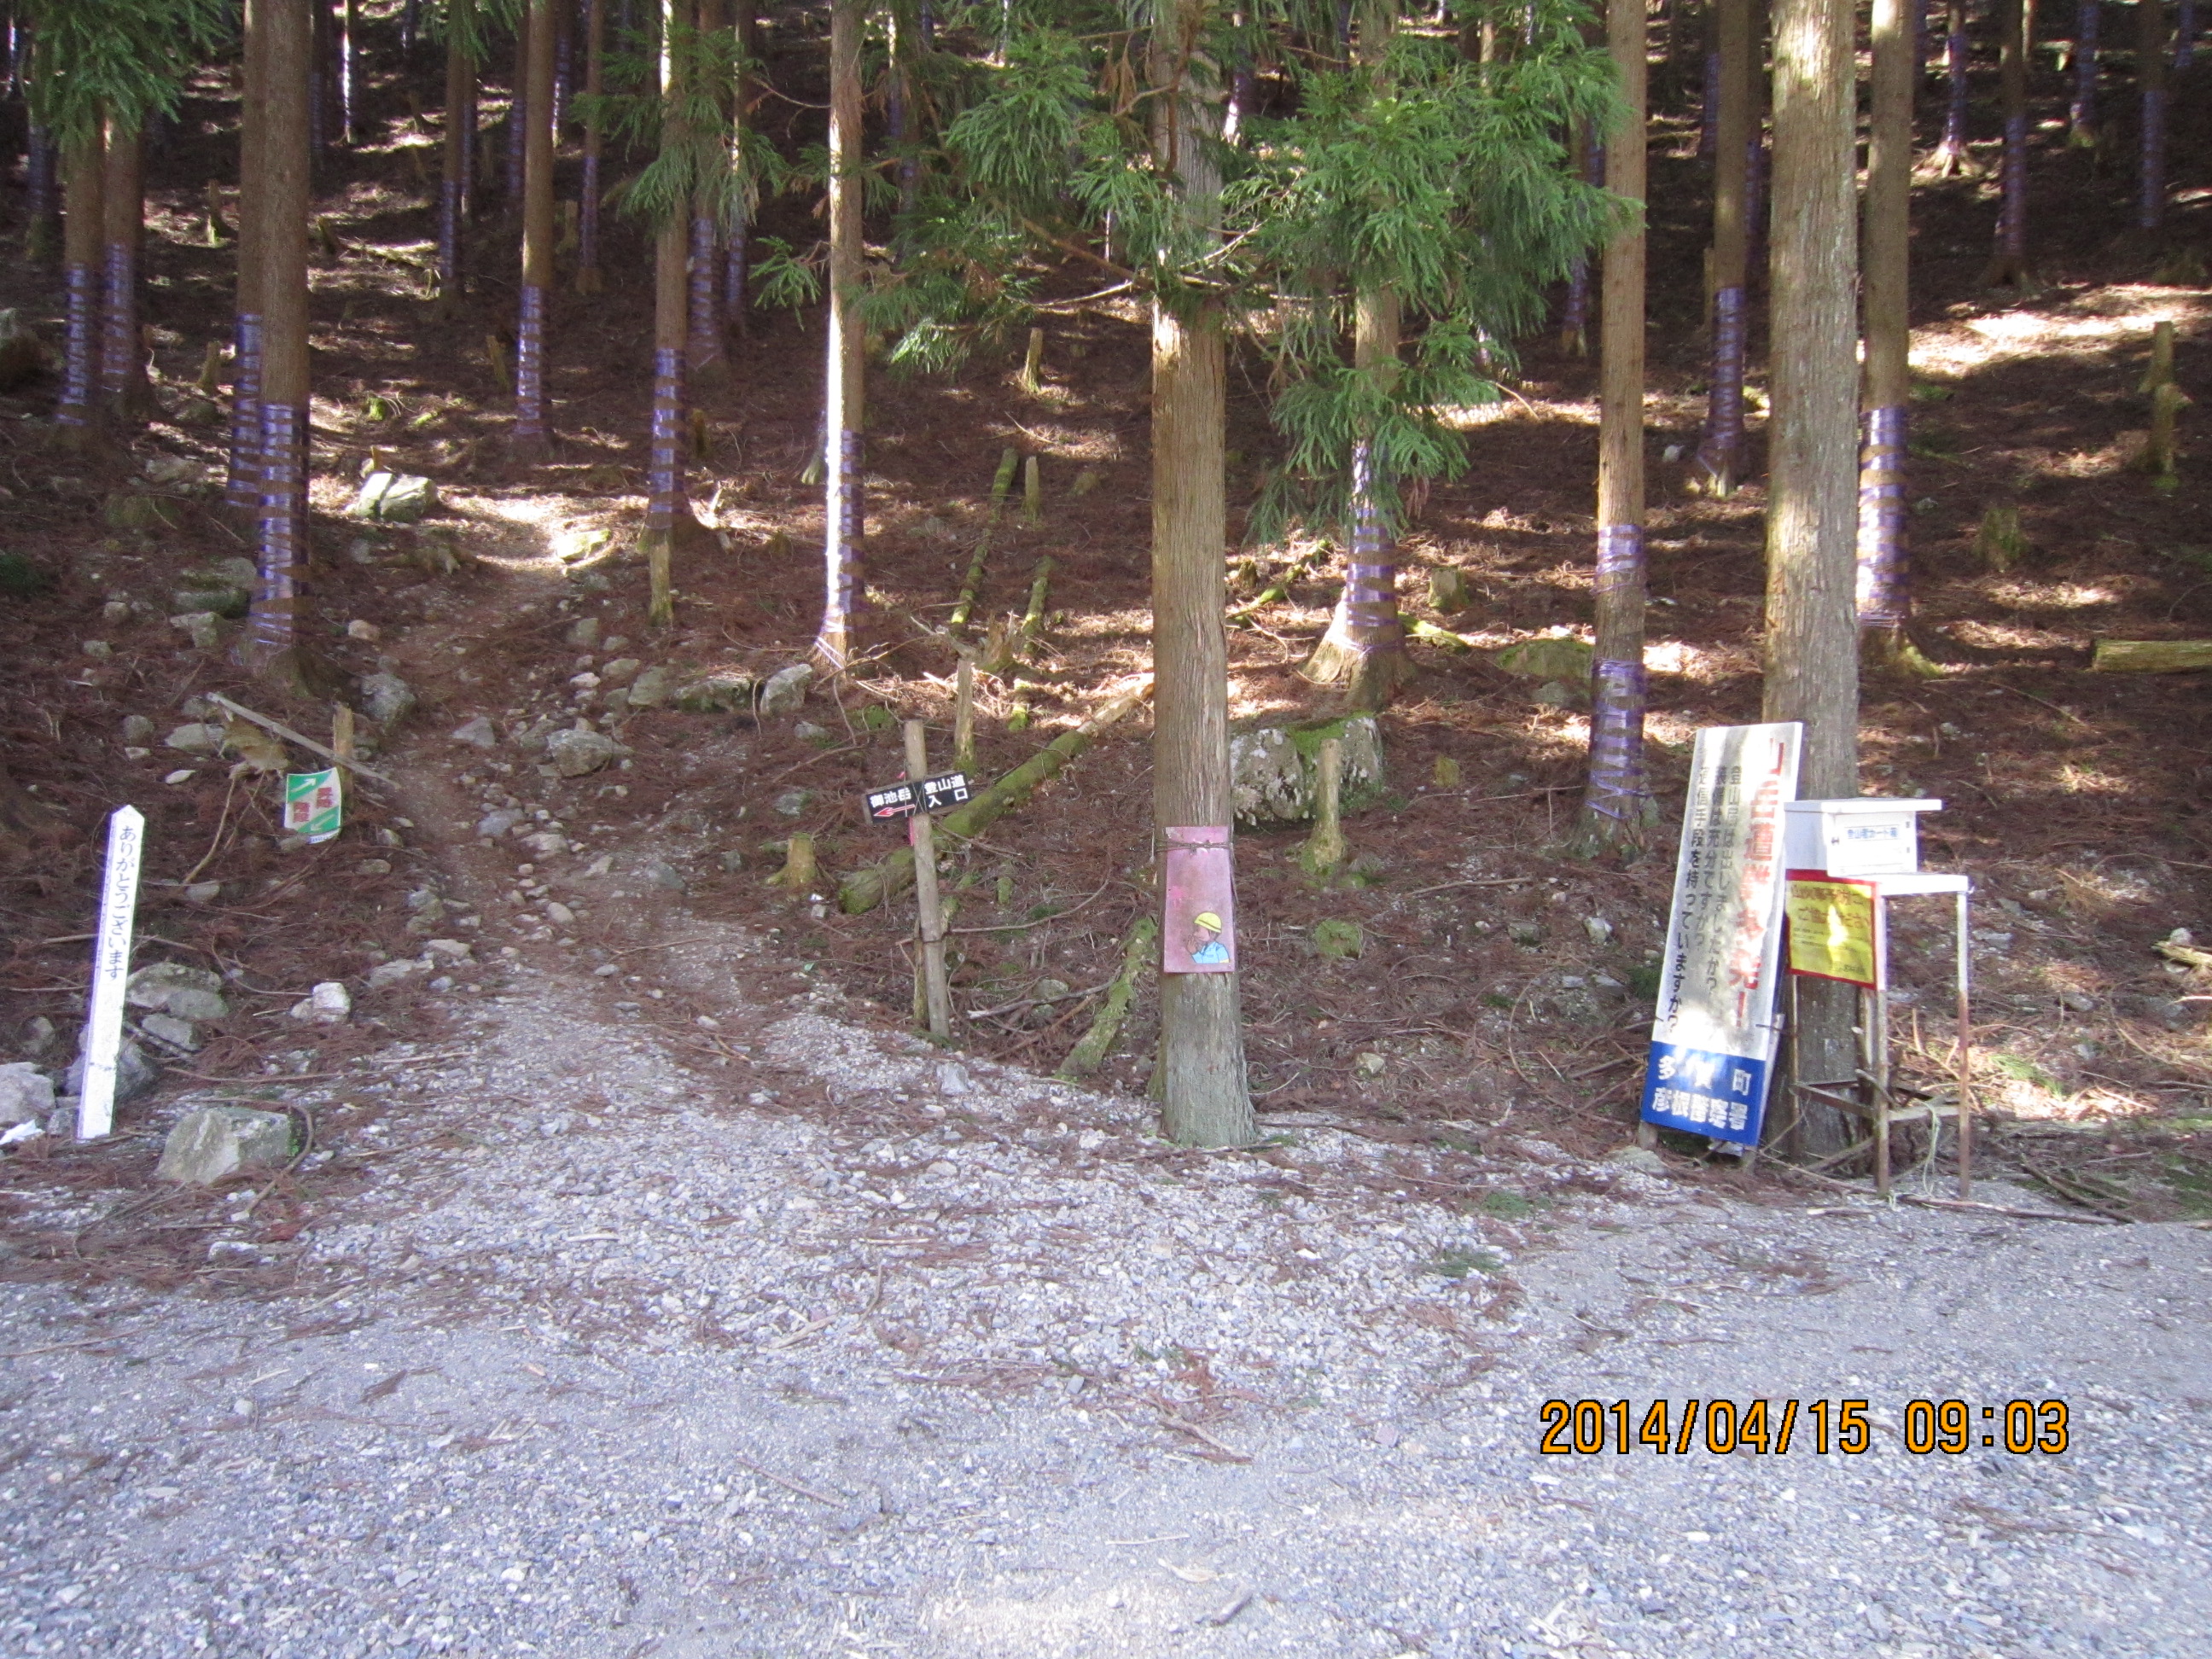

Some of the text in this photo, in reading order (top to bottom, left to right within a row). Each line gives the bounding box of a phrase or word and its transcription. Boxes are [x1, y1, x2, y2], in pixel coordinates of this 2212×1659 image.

[870, 787, 911, 807] 御池岳
[924, 774, 965, 795] 登山道
[105, 825, 137, 981] ありがとうございます
[1652, 1087, 1749, 1131] 彦根警察署
